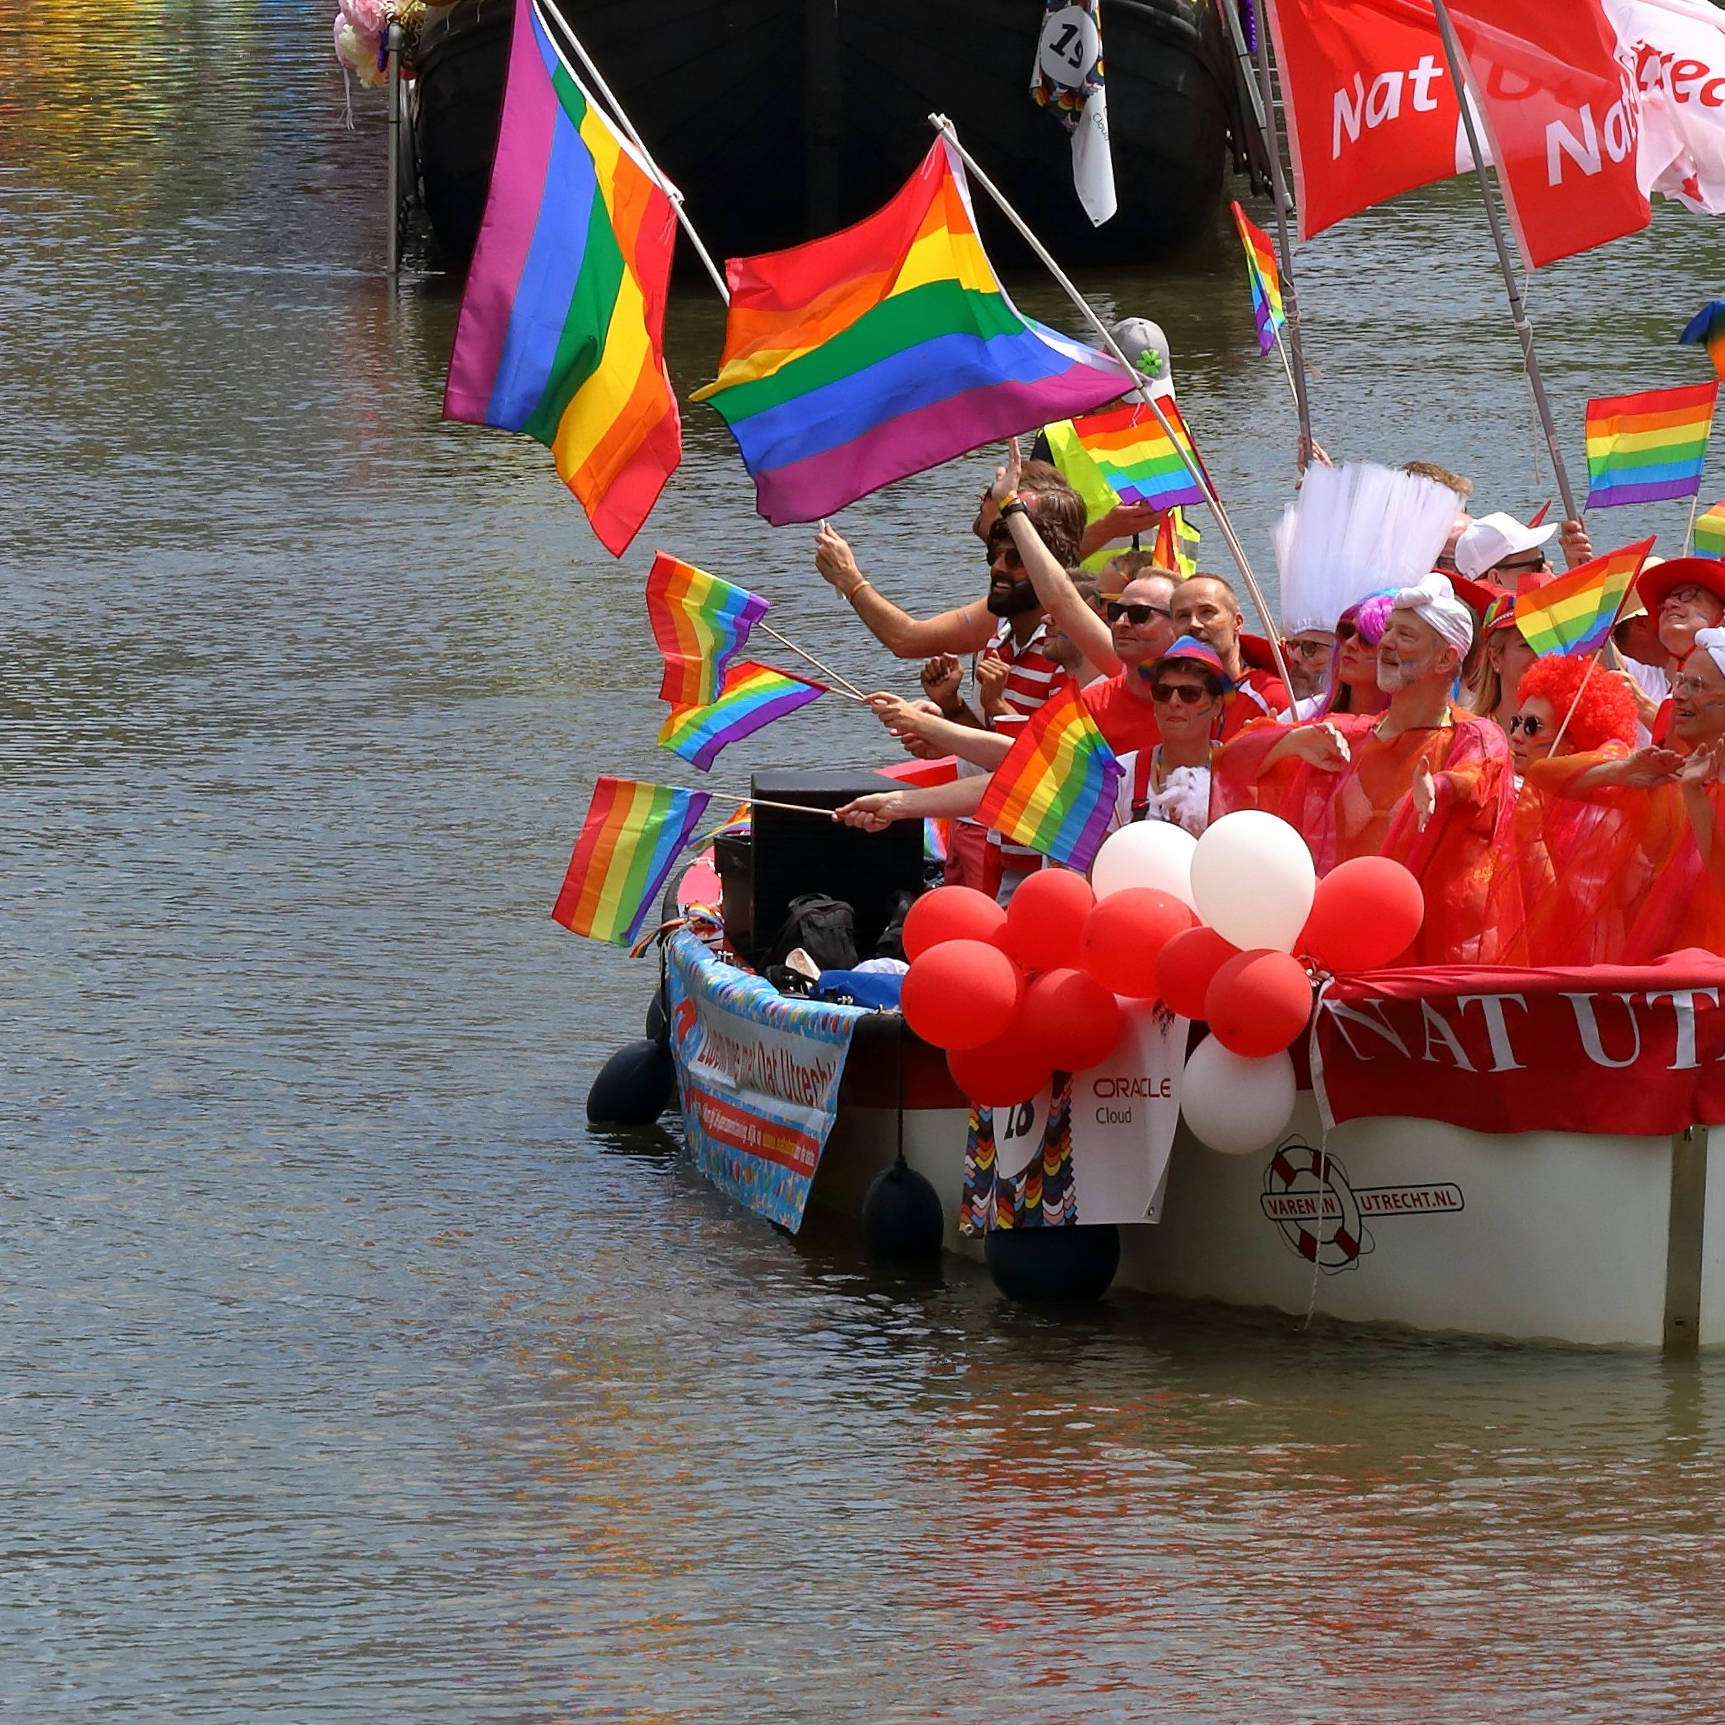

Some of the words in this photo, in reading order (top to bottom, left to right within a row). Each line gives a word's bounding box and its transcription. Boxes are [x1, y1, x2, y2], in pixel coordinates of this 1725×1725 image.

[1332, 54, 1445, 161] Nat
[1323, 992, 1529, 1074] NAT
[1093, 1077, 1172, 1099] ORACLE
[1095, 1106, 1133, 1125] Cloud
[1267, 1197, 1317, 1215] VAREN
[1320, 1196, 1336, 1214] IN
[1359, 1189, 1458, 1212] UTRECHT.NL
